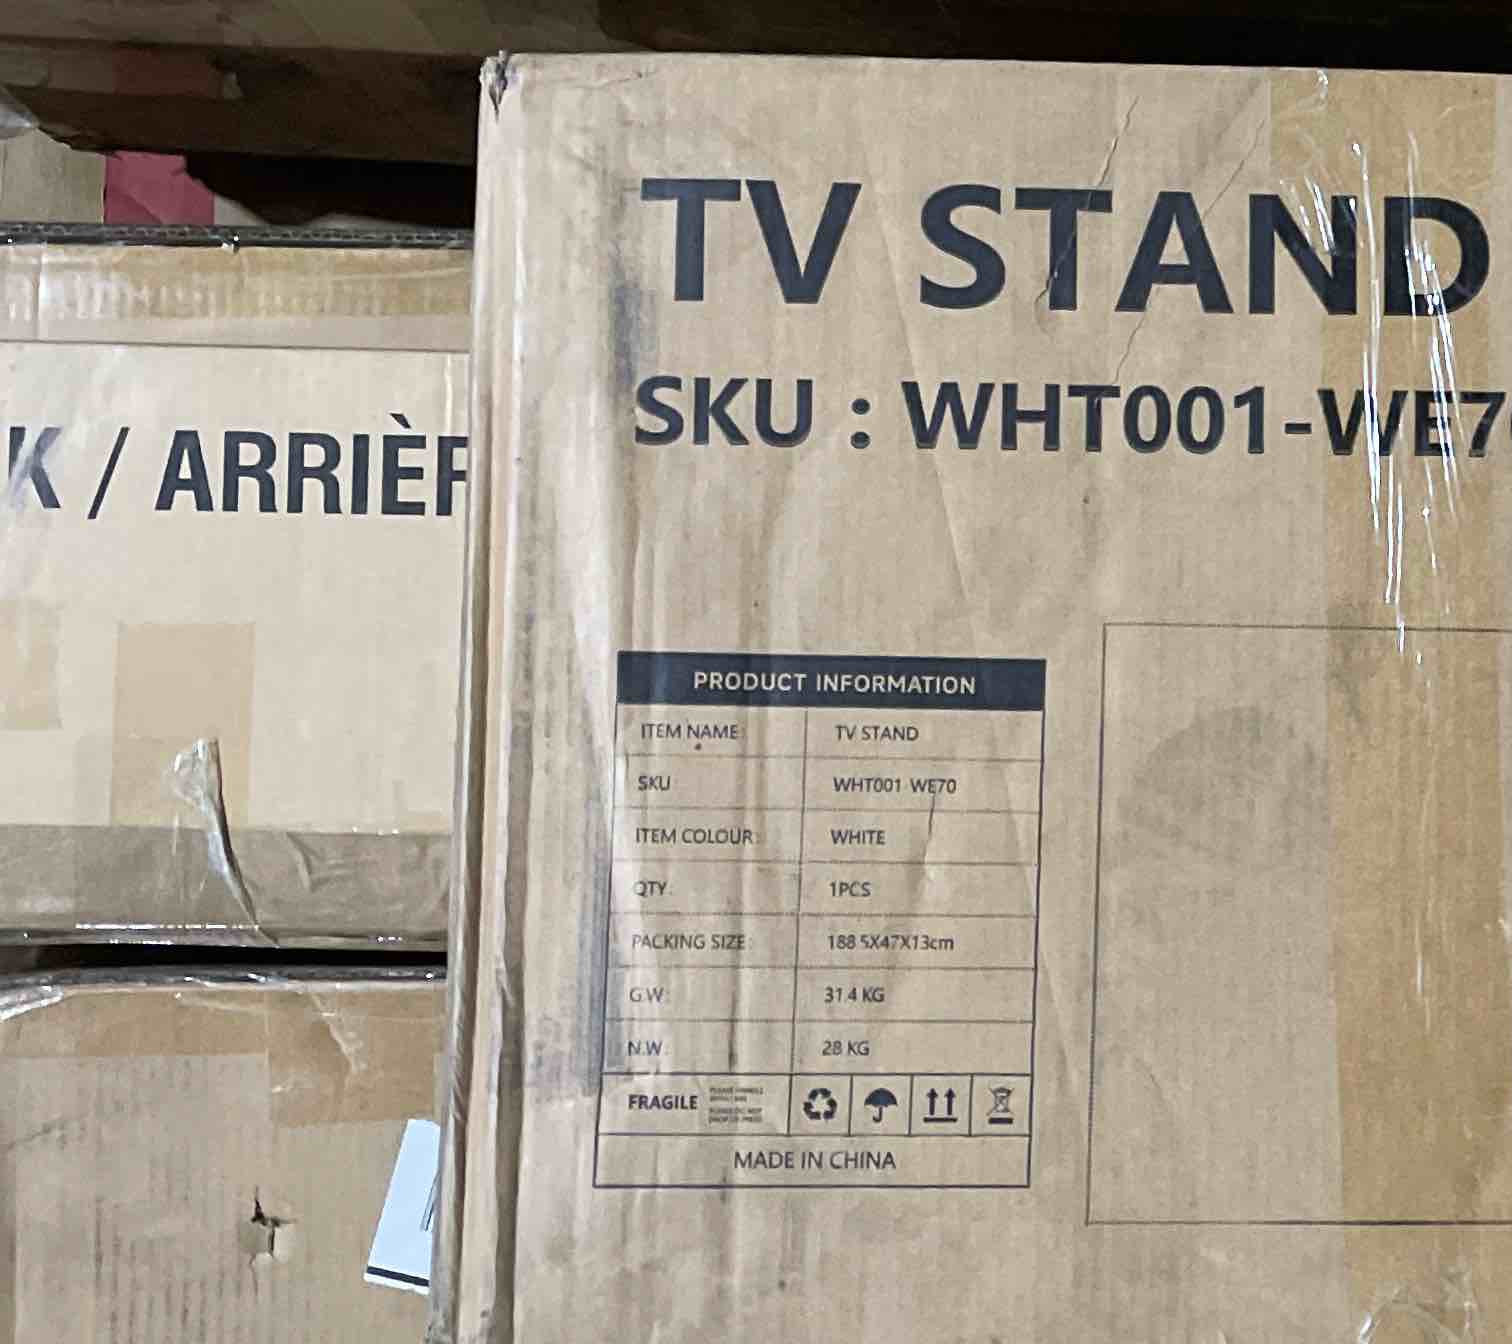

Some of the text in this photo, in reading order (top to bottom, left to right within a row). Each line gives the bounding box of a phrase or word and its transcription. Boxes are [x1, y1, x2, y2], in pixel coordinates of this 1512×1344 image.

[641, 177, 1491, 320] TV STAND
[634, 375, 814, 447] SKU
[87, 426, 130, 520] /
[693, 670, 977, 695] PRODUCT INFORMATION
[640, 723, 682, 740] ITEM
[835, 725, 920, 742] TV STAND
[635, 827, 677, 845] ITEM
[830, 829, 887, 846] WHITE
[829, 880, 872, 898] 1PCS
[631, 933, 706, 950] PACKING
[861, 986, 886, 1004] KG
[821, 1040, 871, 1056] 28 KG
[628, 1093, 699, 1111] FRAGILE
[733, 1151, 898, 1170] MADE IN CHINA
